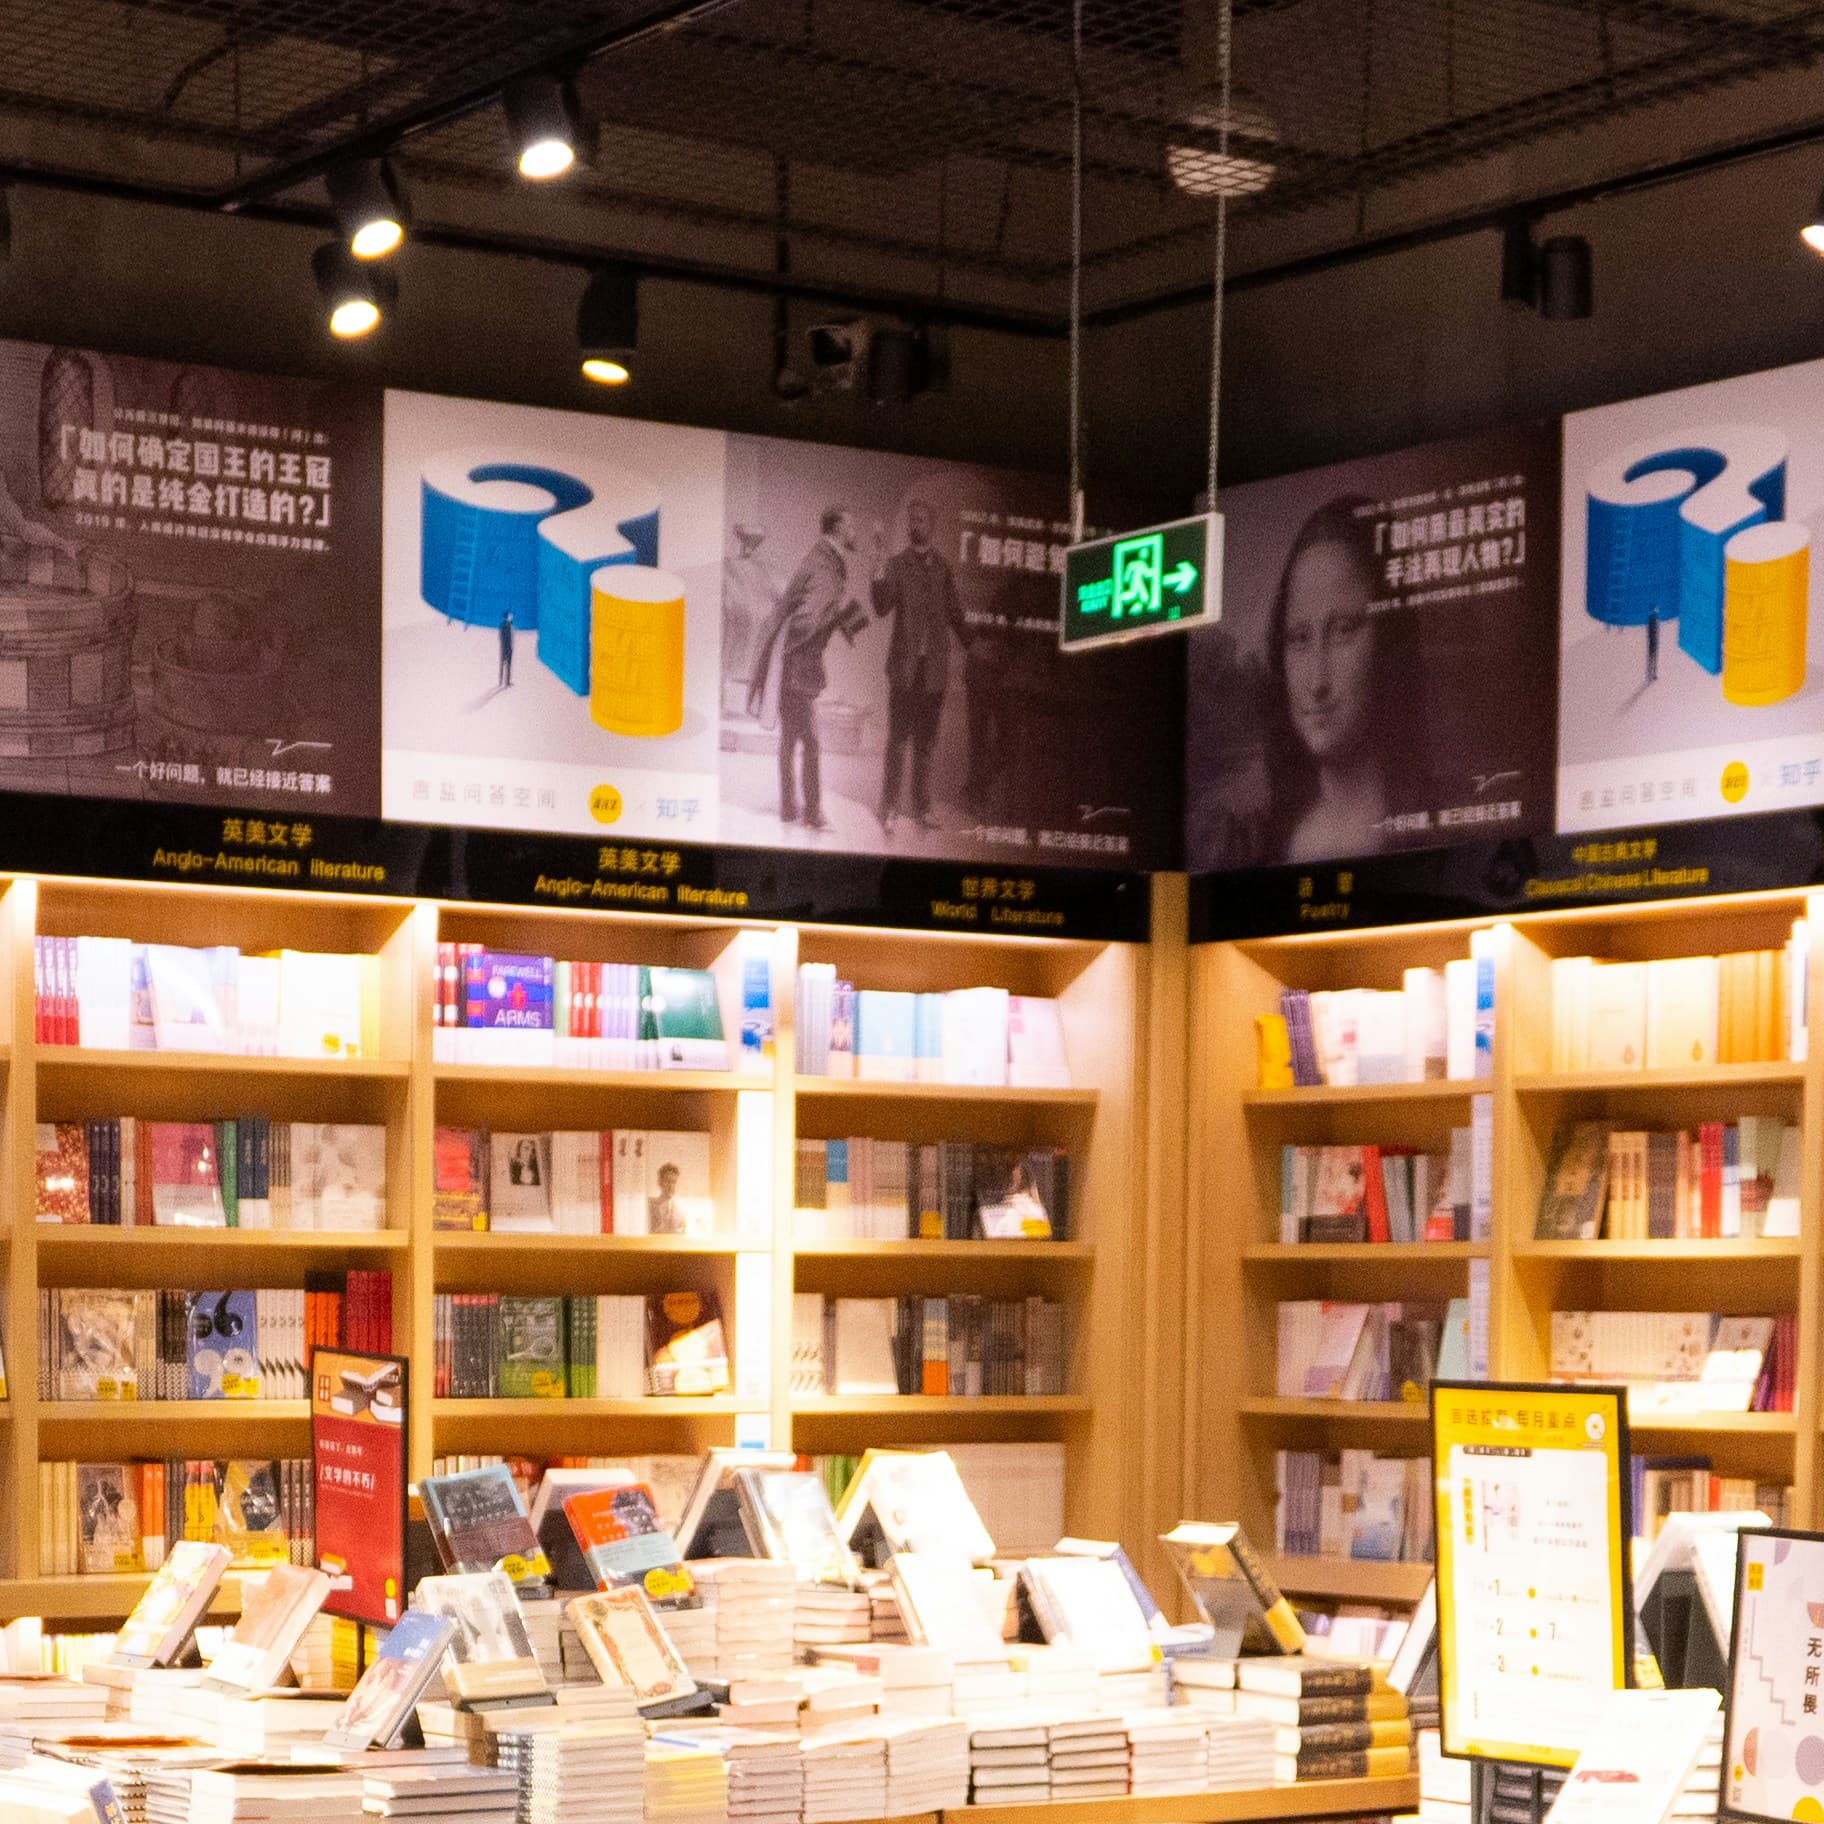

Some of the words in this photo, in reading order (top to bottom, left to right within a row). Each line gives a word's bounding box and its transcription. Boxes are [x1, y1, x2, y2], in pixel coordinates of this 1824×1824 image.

[61, 423, 332, 490] 「如何确定国王的王冠
[114, 759, 332, 796] 一个好问题，就已经接近答案
[656, 796, 702, 822] 知乎
[221, 816, 314, 849] 英美文学
[151, 847, 301, 879] Anglo-American
[308, 856, 387, 881] literature
[598, 845, 682, 876] 英美文学
[533, 873, 669, 902] Anglo-American
[676, 883, 750, 908] literature
[494, 1007, 543, 1028] ARMS
